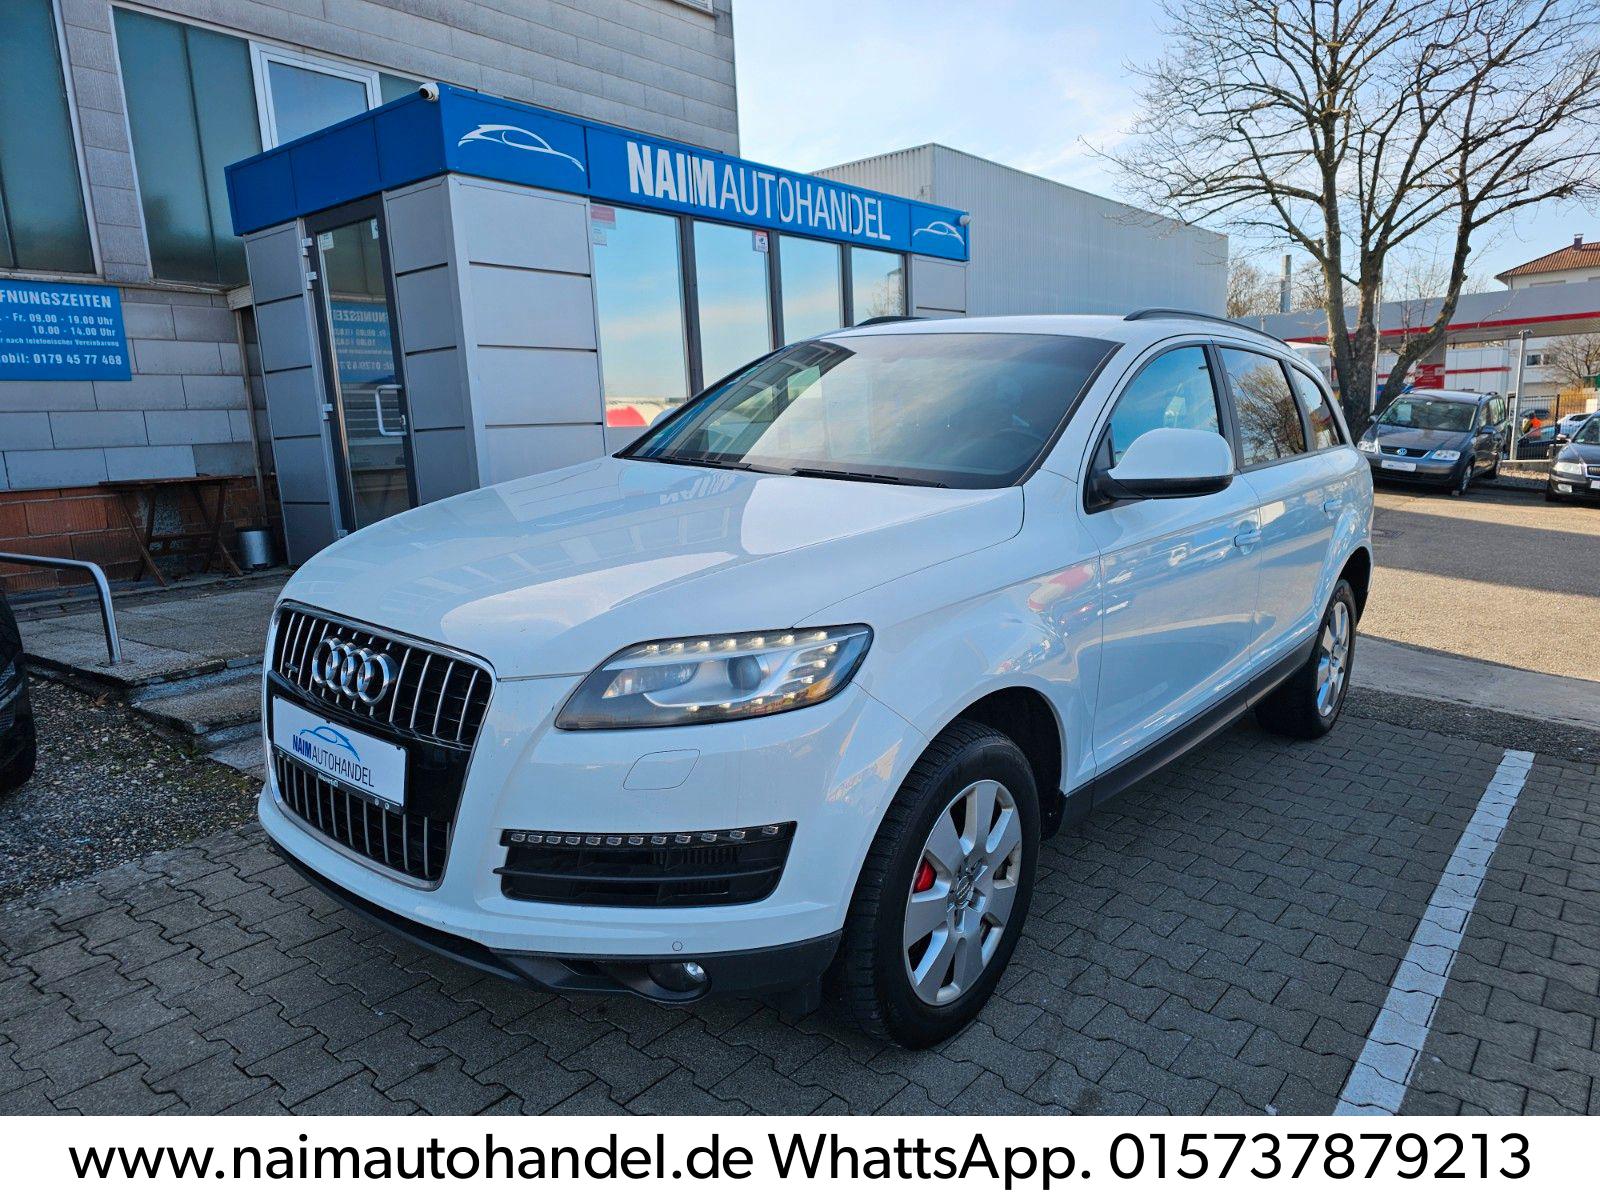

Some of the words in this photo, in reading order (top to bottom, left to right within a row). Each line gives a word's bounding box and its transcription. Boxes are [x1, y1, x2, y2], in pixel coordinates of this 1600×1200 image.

[627, 141, 717, 209] NAIM
[720, 164, 891, 241] AUTOHANDEL
[13, 312, 26, 322] Fr.
[29, 313, 57, 323] 09.00
[69, 315, 95, 325] 19.00
[97, 316, 114, 325] Uhr
[32, 325, 60, 335] 10.00
[71, 327, 97, 336] 14.00
[100, 328, 116, 337] Uhr
[33, 353, 63, 364] 0179
[66, 354, 81, 365] 45
[84, 354, 98, 364] 77
[292, 734, 312, 759] NAIM
[311, 745, 375, 788] AUTOHANDEL
